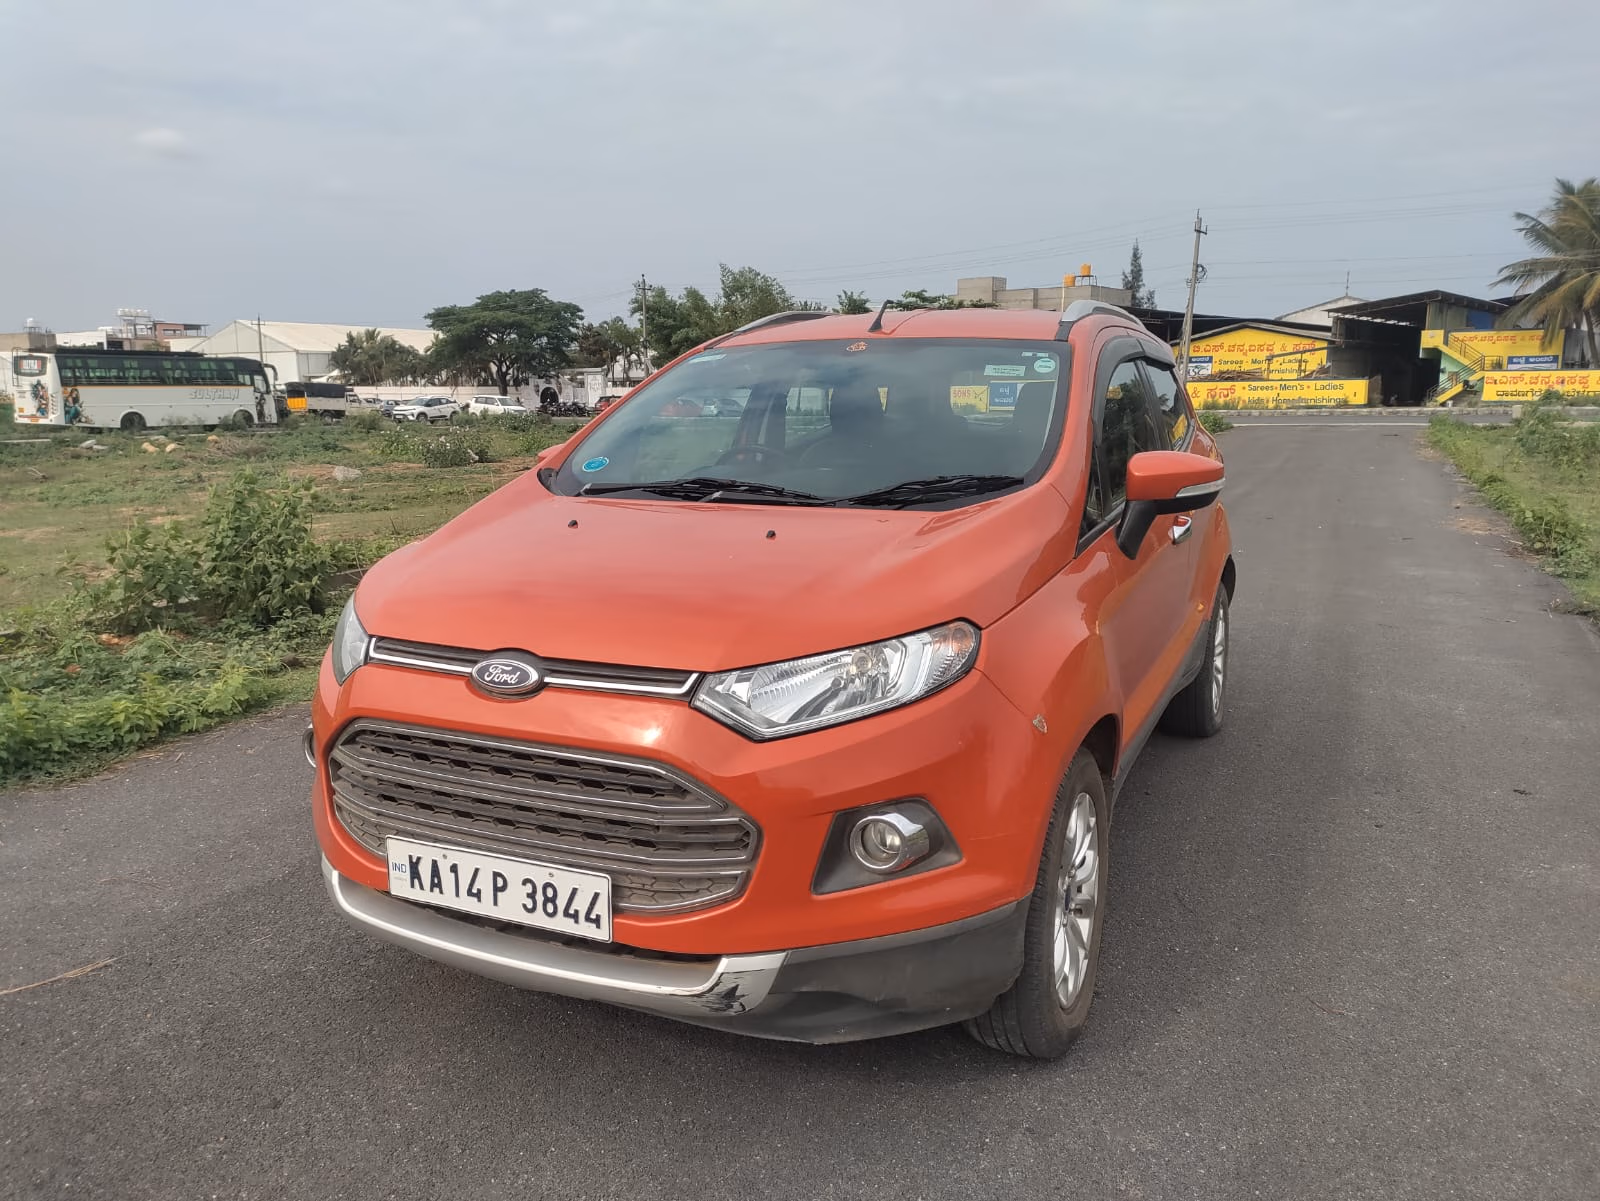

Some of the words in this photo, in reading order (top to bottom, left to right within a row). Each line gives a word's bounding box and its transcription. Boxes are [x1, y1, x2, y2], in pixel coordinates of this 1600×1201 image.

[1280, 343, 1288, 352] &
[1315, 382, 1344, 390] Ladies
[1190, 386, 1201, 399] &
[484, 664, 521, 684] Ford
[391, 861, 407, 873] IND
[521, 877, 601, 930] 3844
